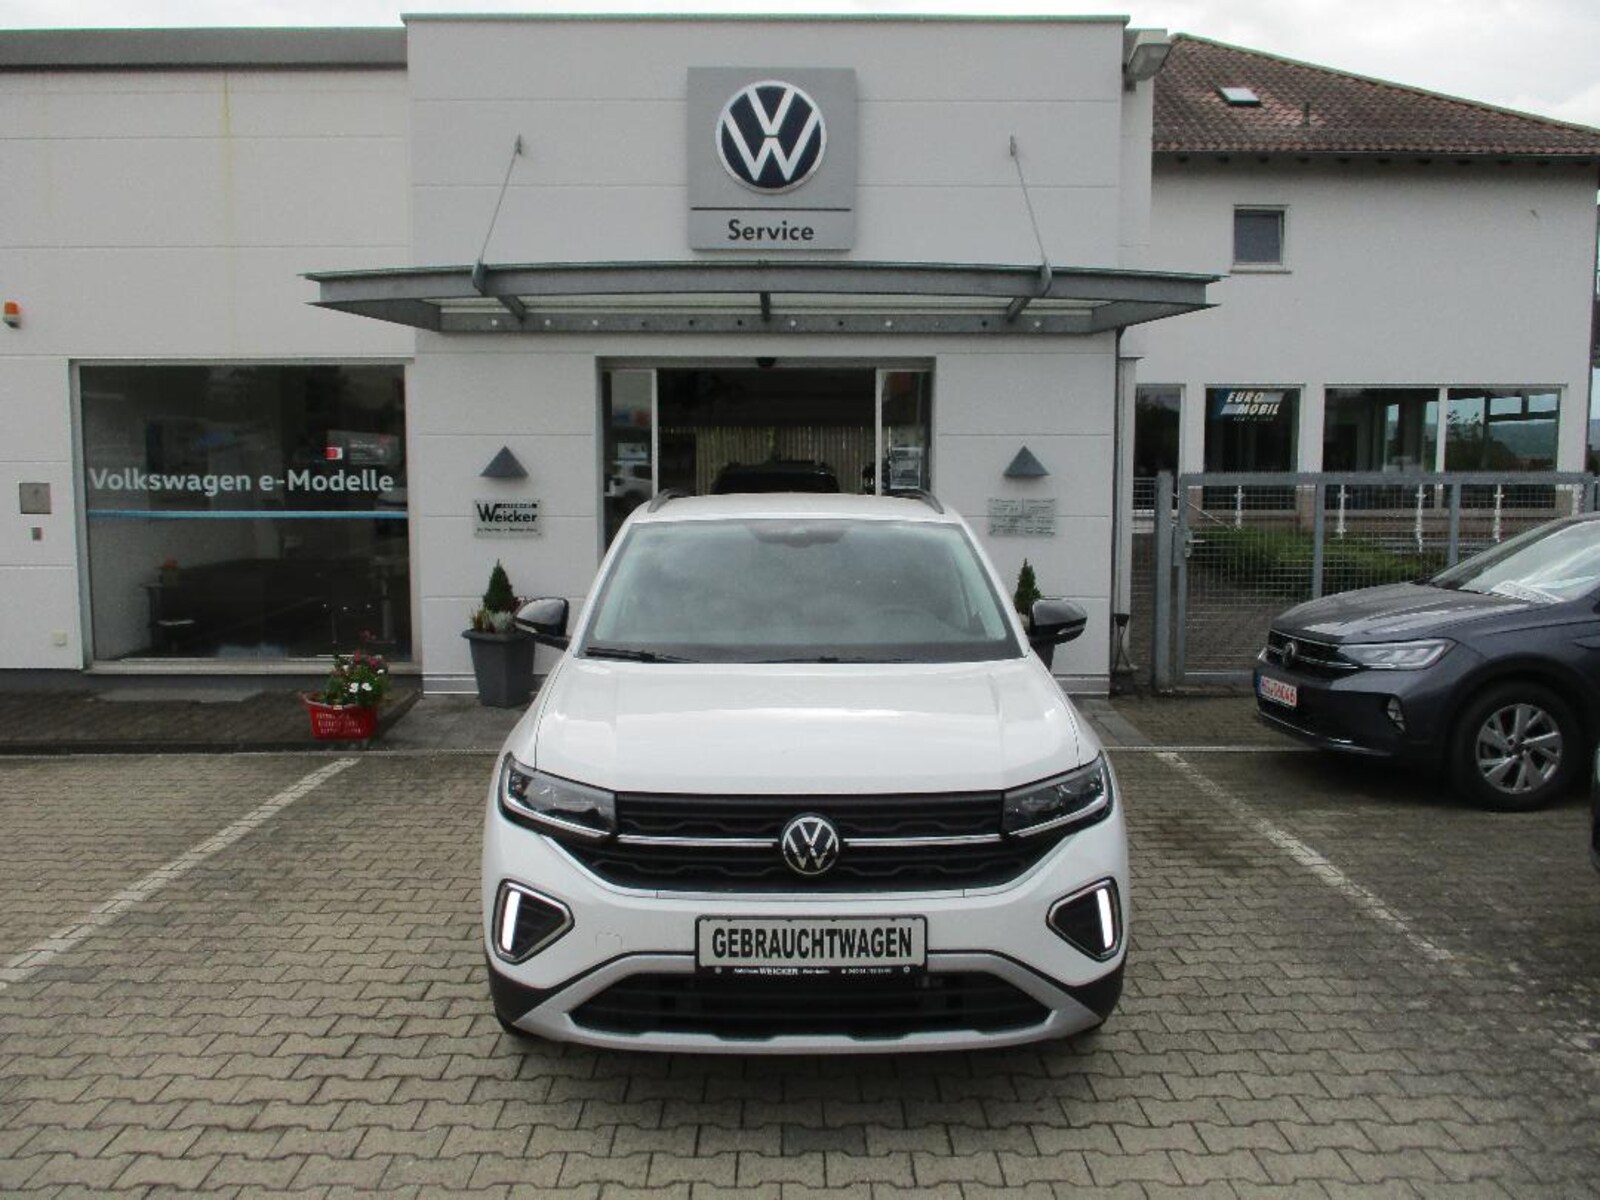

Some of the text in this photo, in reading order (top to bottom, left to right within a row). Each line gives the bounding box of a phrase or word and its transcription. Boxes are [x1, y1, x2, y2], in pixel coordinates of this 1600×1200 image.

[727, 218, 815, 241] Service
[1226, 391, 1265, 404] EURO
[1237, 403, 1280, 415] MOBIL
[89, 467, 395, 496] Volkswagen e-Modelle
[476, 503, 538, 522] Weicker
[711, 926, 913, 958] GEBRAUCHTWAGEN
